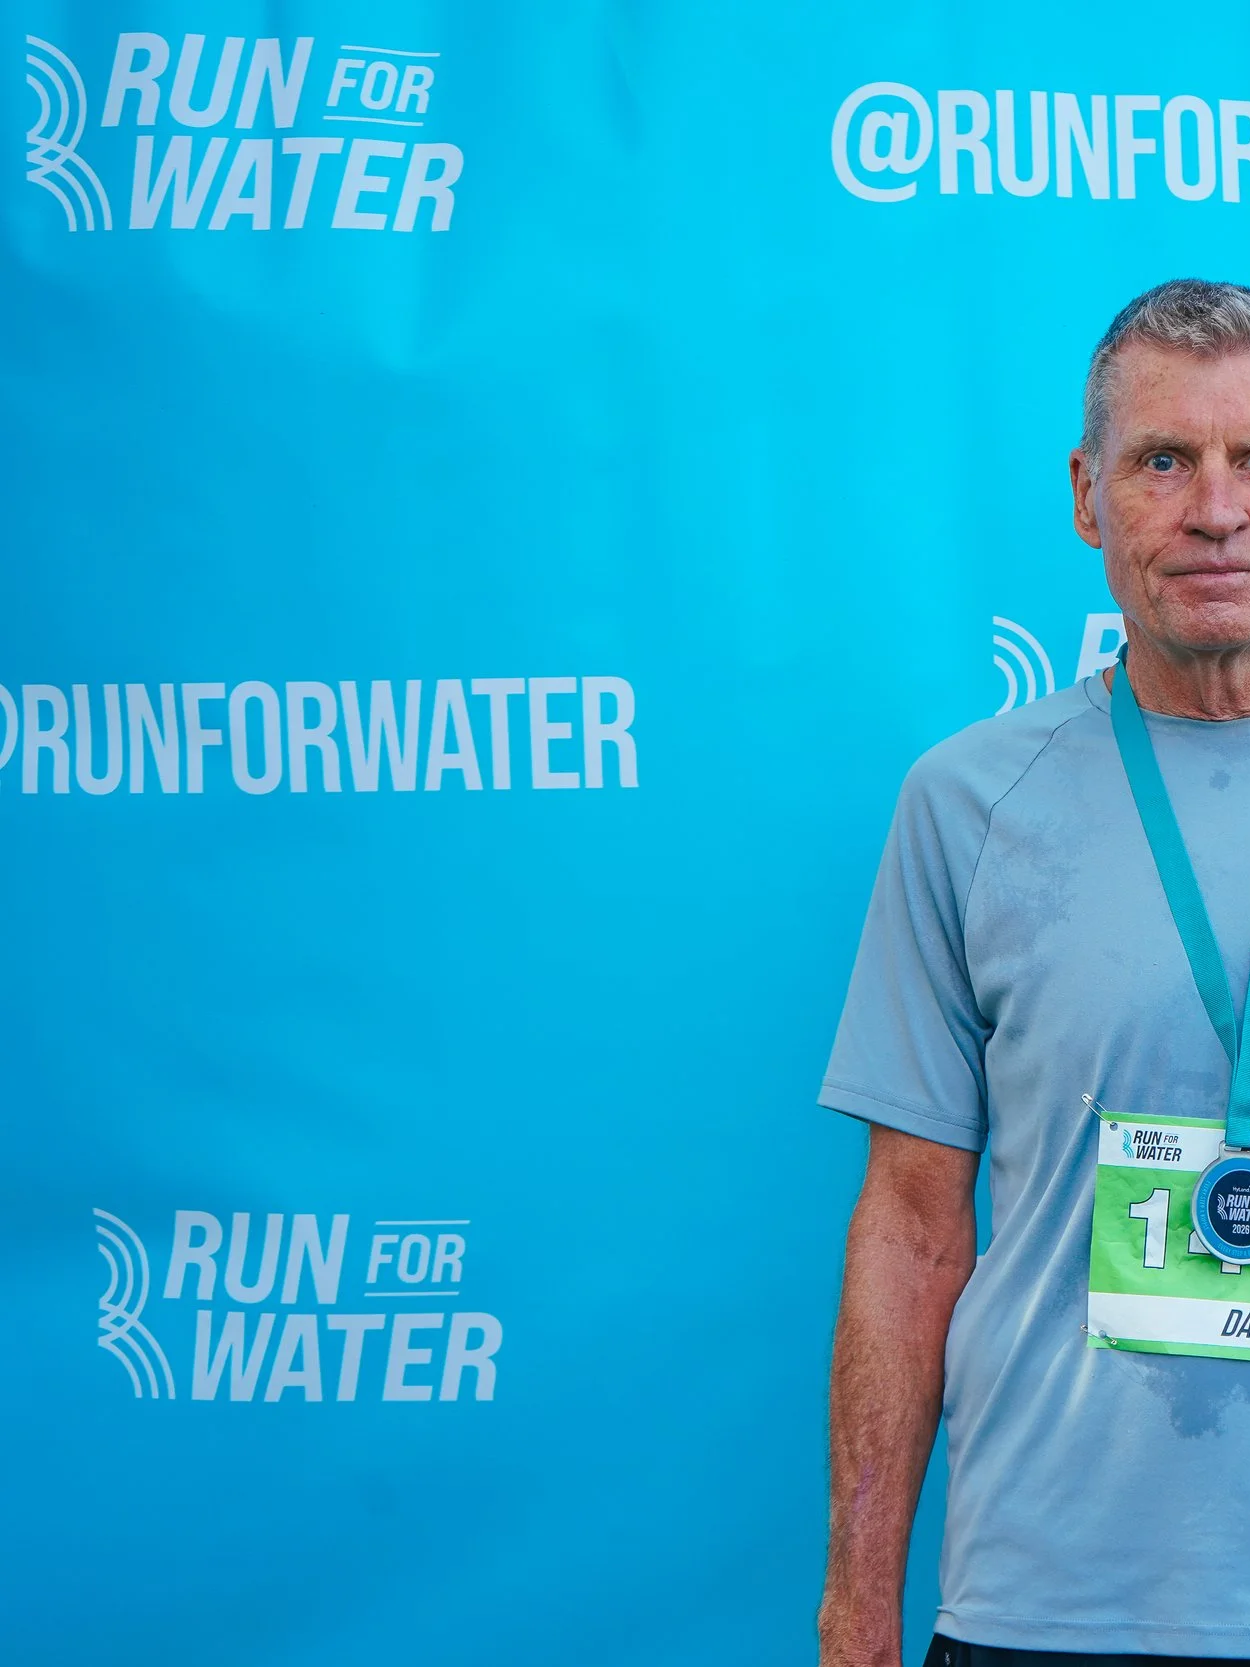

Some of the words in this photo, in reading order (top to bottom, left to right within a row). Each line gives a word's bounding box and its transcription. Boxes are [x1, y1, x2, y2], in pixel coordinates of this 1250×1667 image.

[101, 32, 314, 129] RUN
[326, 59, 435, 114] FOR
[129, 135, 465, 232] WATER
[0, 676, 639, 795] RUNFORWATER
[1133, 1130, 1163, 1145] RUN
[1164, 1135, 1179, 1144] FOR
[1136, 1145, 1182, 1162] WATER
[1226, 1194, 1250, 1208] RUN
[1232, 1224, 1250, 1235] 2026
[163, 1210, 350, 1304] RUN
[366, 1233, 466, 1284] FOR
[191, 1310, 503, 1402] WATER
